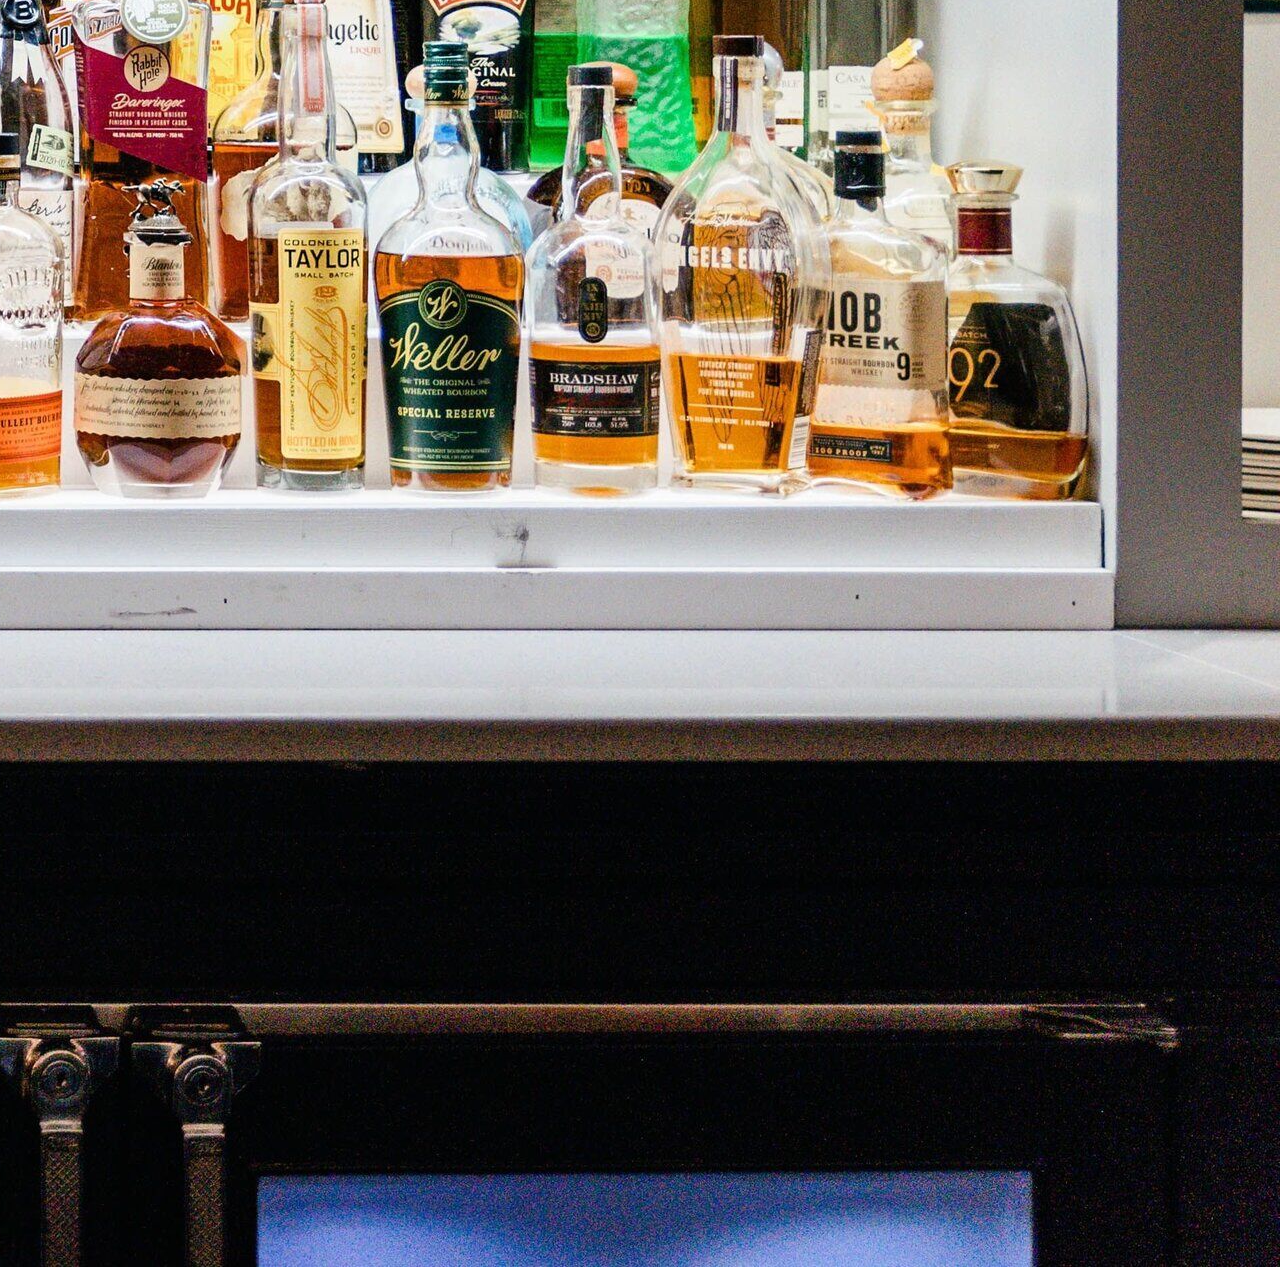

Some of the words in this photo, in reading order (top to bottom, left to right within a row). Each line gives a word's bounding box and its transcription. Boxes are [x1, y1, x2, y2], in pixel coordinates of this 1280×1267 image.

[131, 51, 163, 79] Rabbit
[469, 57, 495, 69] The
[139, 67, 161, 90] Hole
[110, 92, 186, 112] Dareringer
[283, 238, 340, 247] COLONEL
[284, 248, 361, 269] TAYLOR
[294, 271, 324, 279] SMALL
[389, 322, 503, 372] Weller
[829, 334, 901, 351] REEK
[863, 358, 896, 369] BOURBON
[896, 351, 912, 381] 9
[851, 367, 884, 377] WHISKEY
[413, 378, 430, 386] THE
[431, 378, 477, 387] ORIGINAL
[548, 373, 640, 385] BRADSHAW
[402, 387, 444, 396] WHEATED
[445, 387, 488, 397] BOURBON
[396, 406, 441, 419] SPECIAL
[445, 407, 496, 419] RESERVE
[835, 446, 868, 457] PROOF
